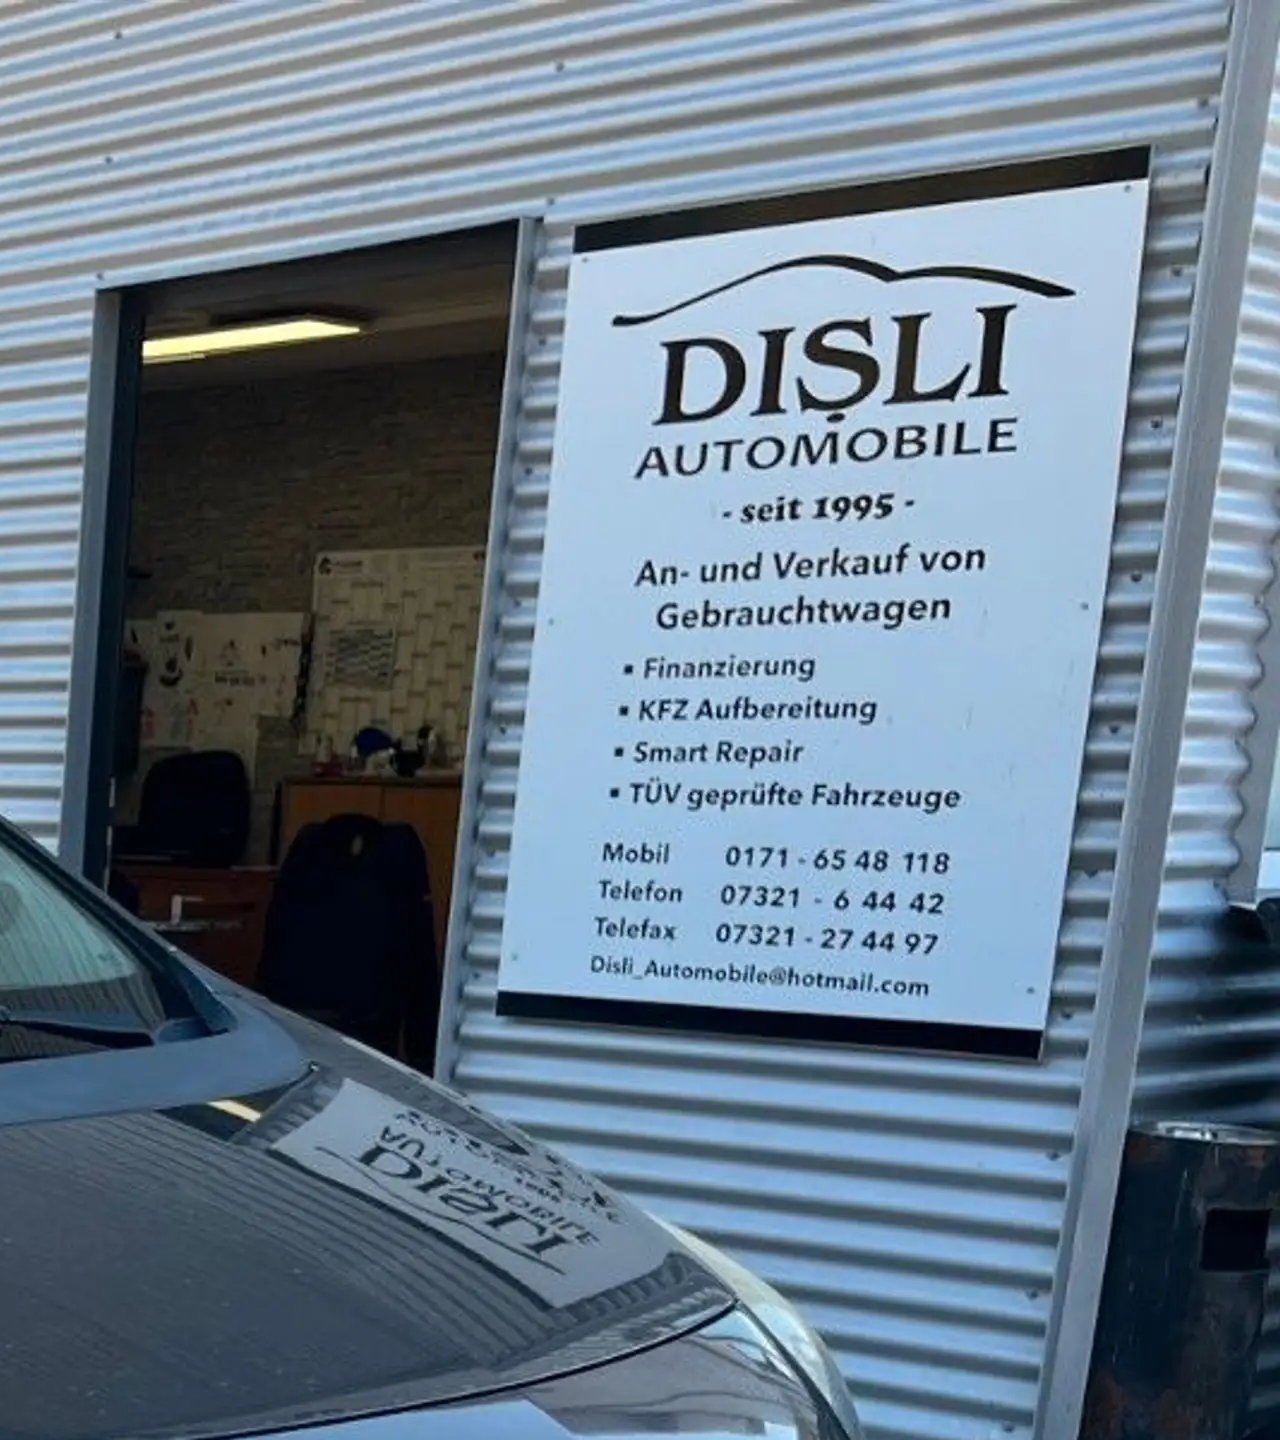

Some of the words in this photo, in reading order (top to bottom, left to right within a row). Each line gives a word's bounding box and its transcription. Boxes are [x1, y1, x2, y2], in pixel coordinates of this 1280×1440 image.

[635, 417, 1019, 479] AUTOMOBILE
[740, 496, 802, 523] seit
[812, 493, 895, 521] 1995
[634, 560, 689, 587] An-
[700, 552, 763, 583] und
[773, 543, 911, 580] Verkauf
[920, 548, 986, 574] von
[656, 595, 951, 631] Gebrauchtwagen
[643, 657, 815, 682] Finanzierung
[639, 699, 689, 721] KFZ
[695, 696, 877, 725] Aufbereitung
[633, 741, 708, 763] Smart
[715, 739, 805, 768] Repair
[630, 777, 682, 805] TÜV
[687, 781, 803, 812] geprüfte
[811, 782, 961, 814] Fahrzeuge
[602, 842, 670, 865] Mobil
[725, 846, 788, 868] 0171
[813, 849, 846, 872] 65
[854, 850, 888, 873] 48
[902, 852, 950, 875] 118
[598, 880, 684, 904] Telefon
[720, 885, 800, 908] 07321
[833, 889, 850, 911] 6
[861, 891, 896, 913] 44
[909, 893, 945, 915] 42
[593, 916, 677, 941] Telefax
[715, 923, 795, 947] 07321
[820, 929, 854, 950] 27
[861, 931, 895, 953] 44
[904, 932, 939, 956] 97
[590, 955, 930, 997] Disli_Automobile@hotmail.com
